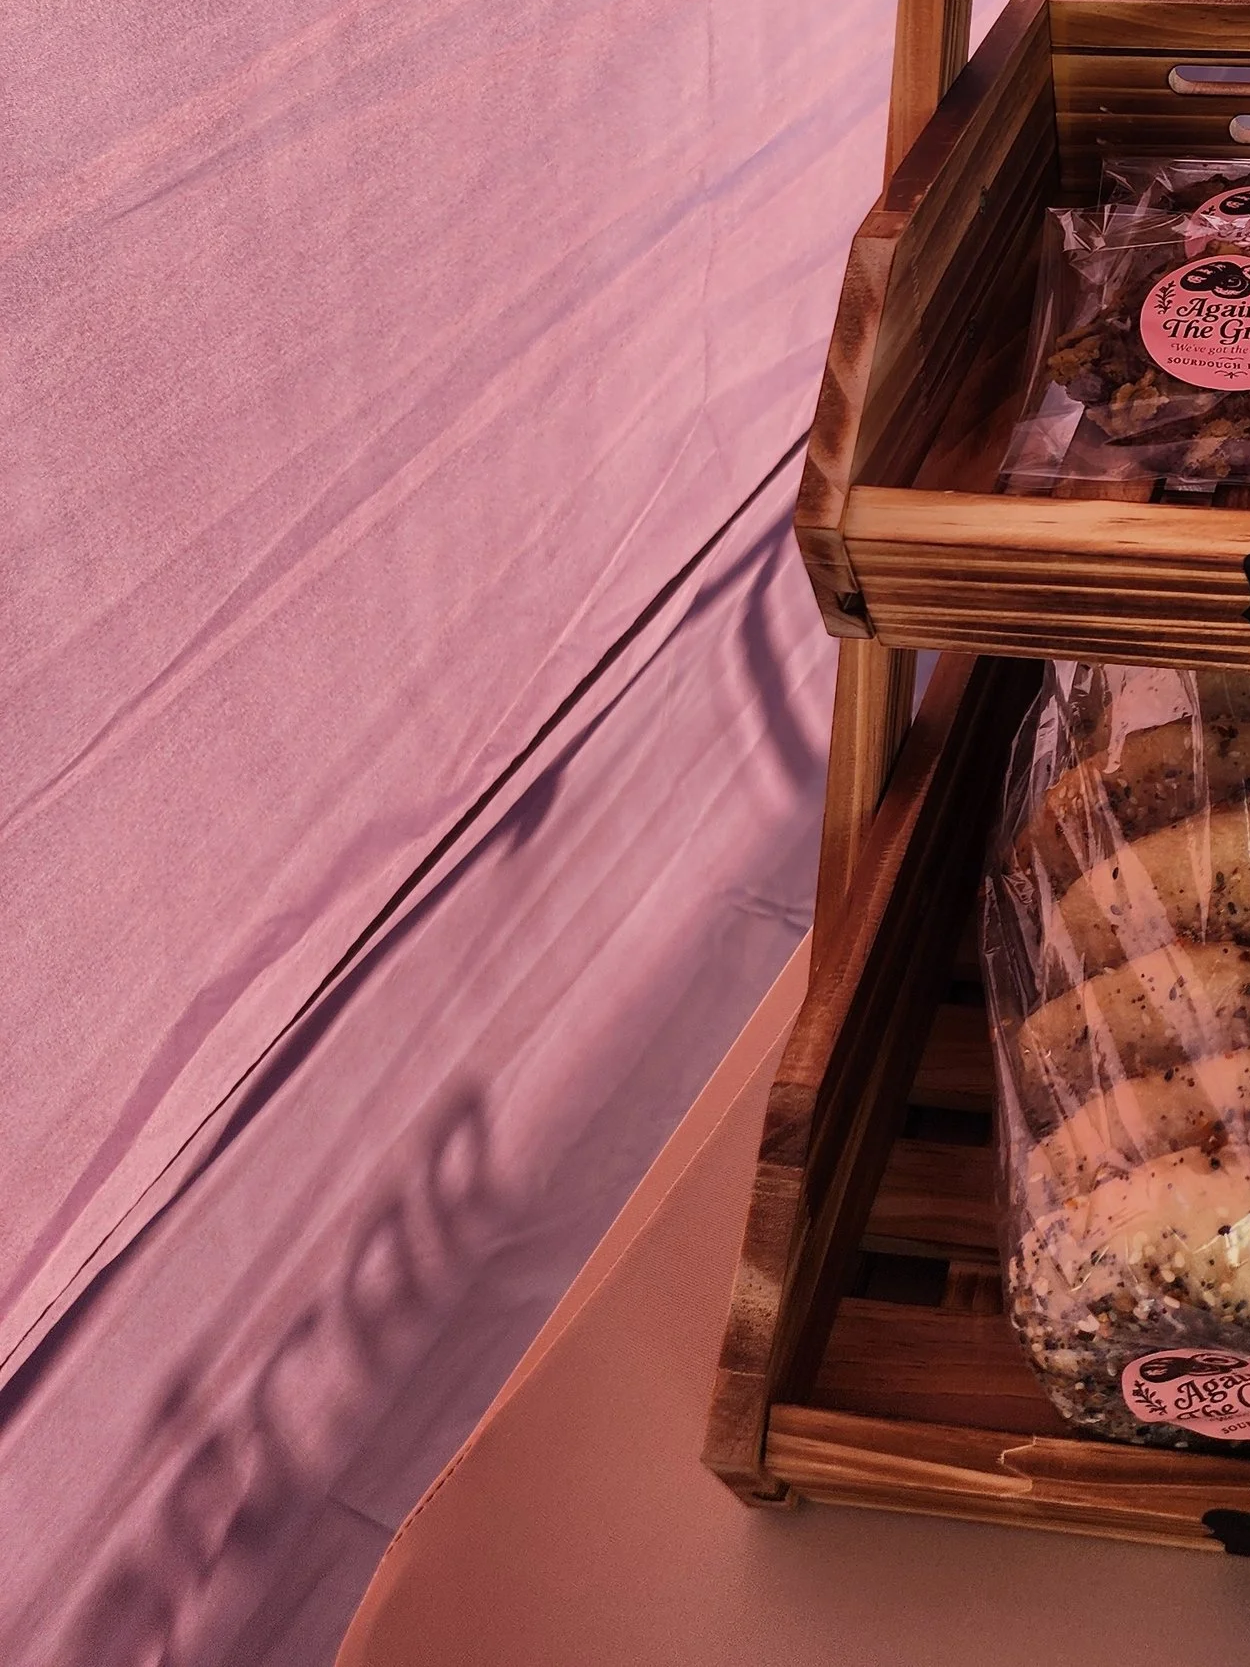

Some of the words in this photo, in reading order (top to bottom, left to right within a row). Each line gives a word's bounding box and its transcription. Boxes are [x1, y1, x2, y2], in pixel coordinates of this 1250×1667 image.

[1162, 319, 1214, 342] The
[1170, 341, 1206, 355] We've
[1208, 345, 1229, 357] got
[1231, 344, 1249, 355] the
[1167, 356, 1241, 370] SOURDOUGH
